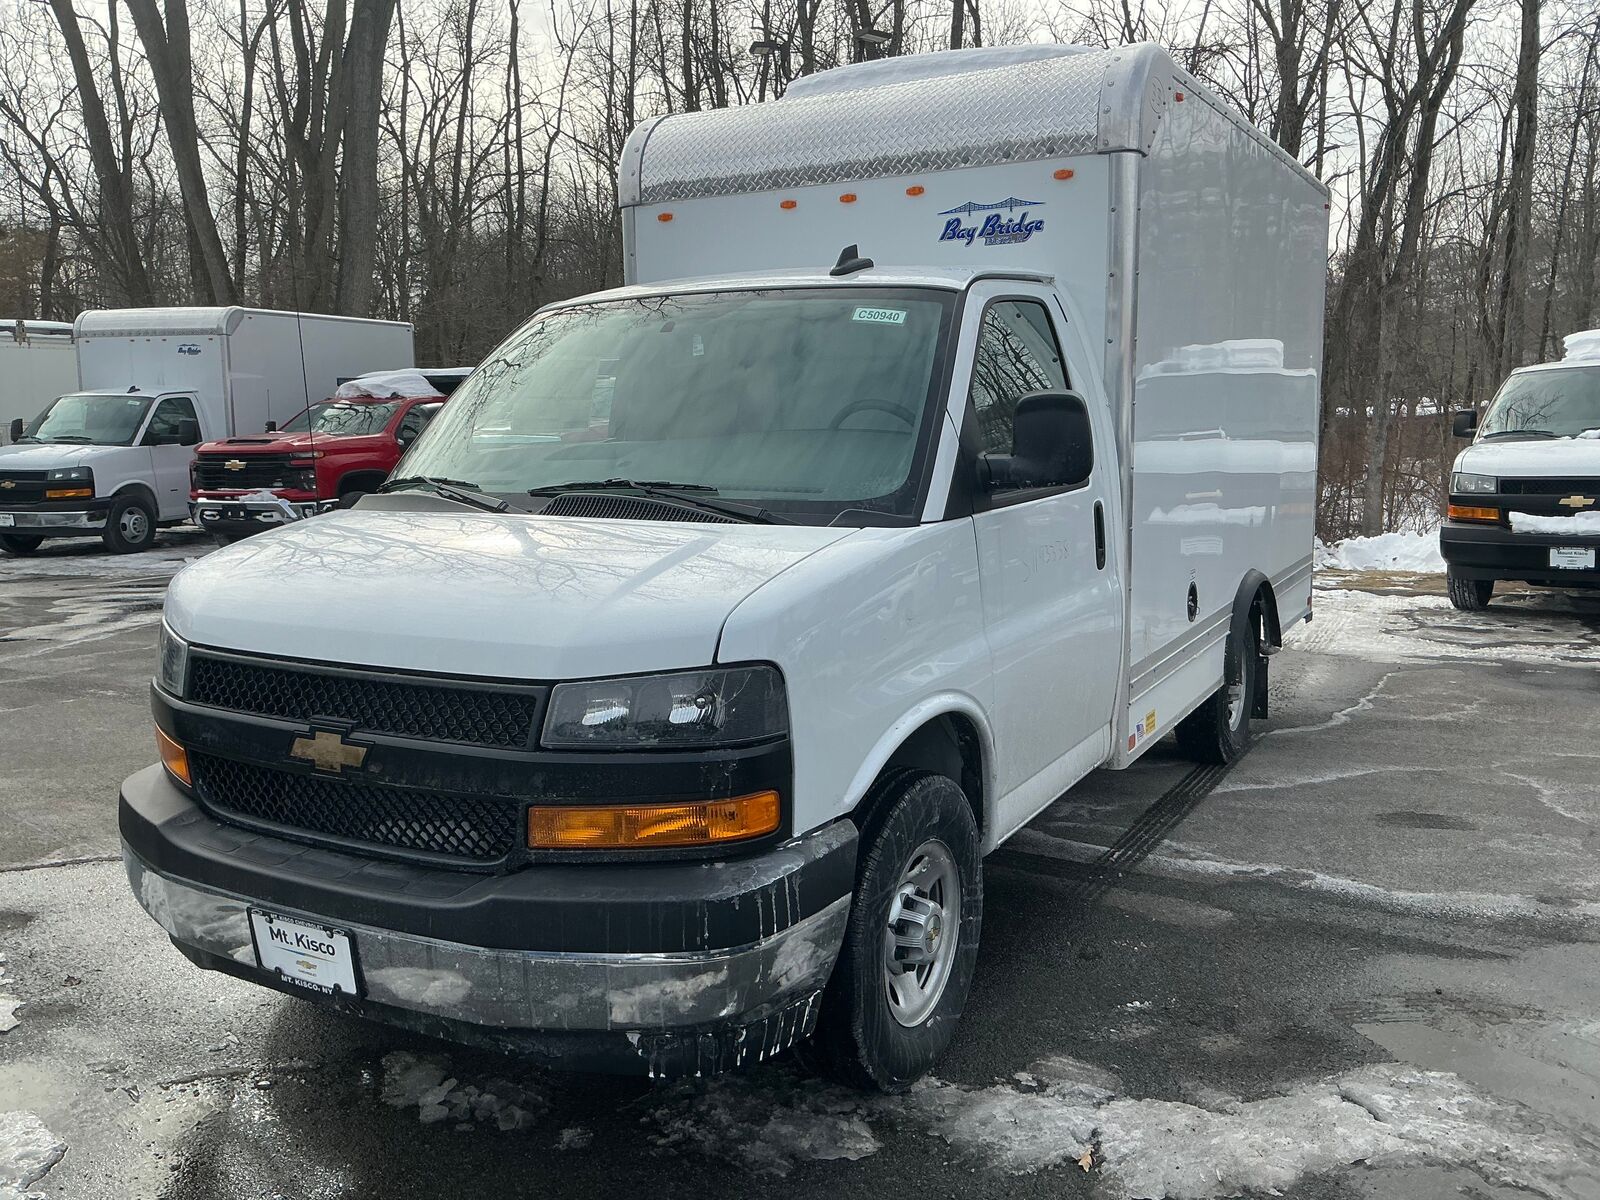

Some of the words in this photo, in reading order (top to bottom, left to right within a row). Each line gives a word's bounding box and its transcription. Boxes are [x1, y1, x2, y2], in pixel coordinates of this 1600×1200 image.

[939, 217, 977, 246] Bay
[977, 212, 1044, 241] Bridge
[858, 310, 900, 321] C50940
[269, 926, 293, 945] Mt.
[295, 932, 335, 956] Kisco
[281, 974, 293, 984] MT.
[322, 986, 333, 994] NY
